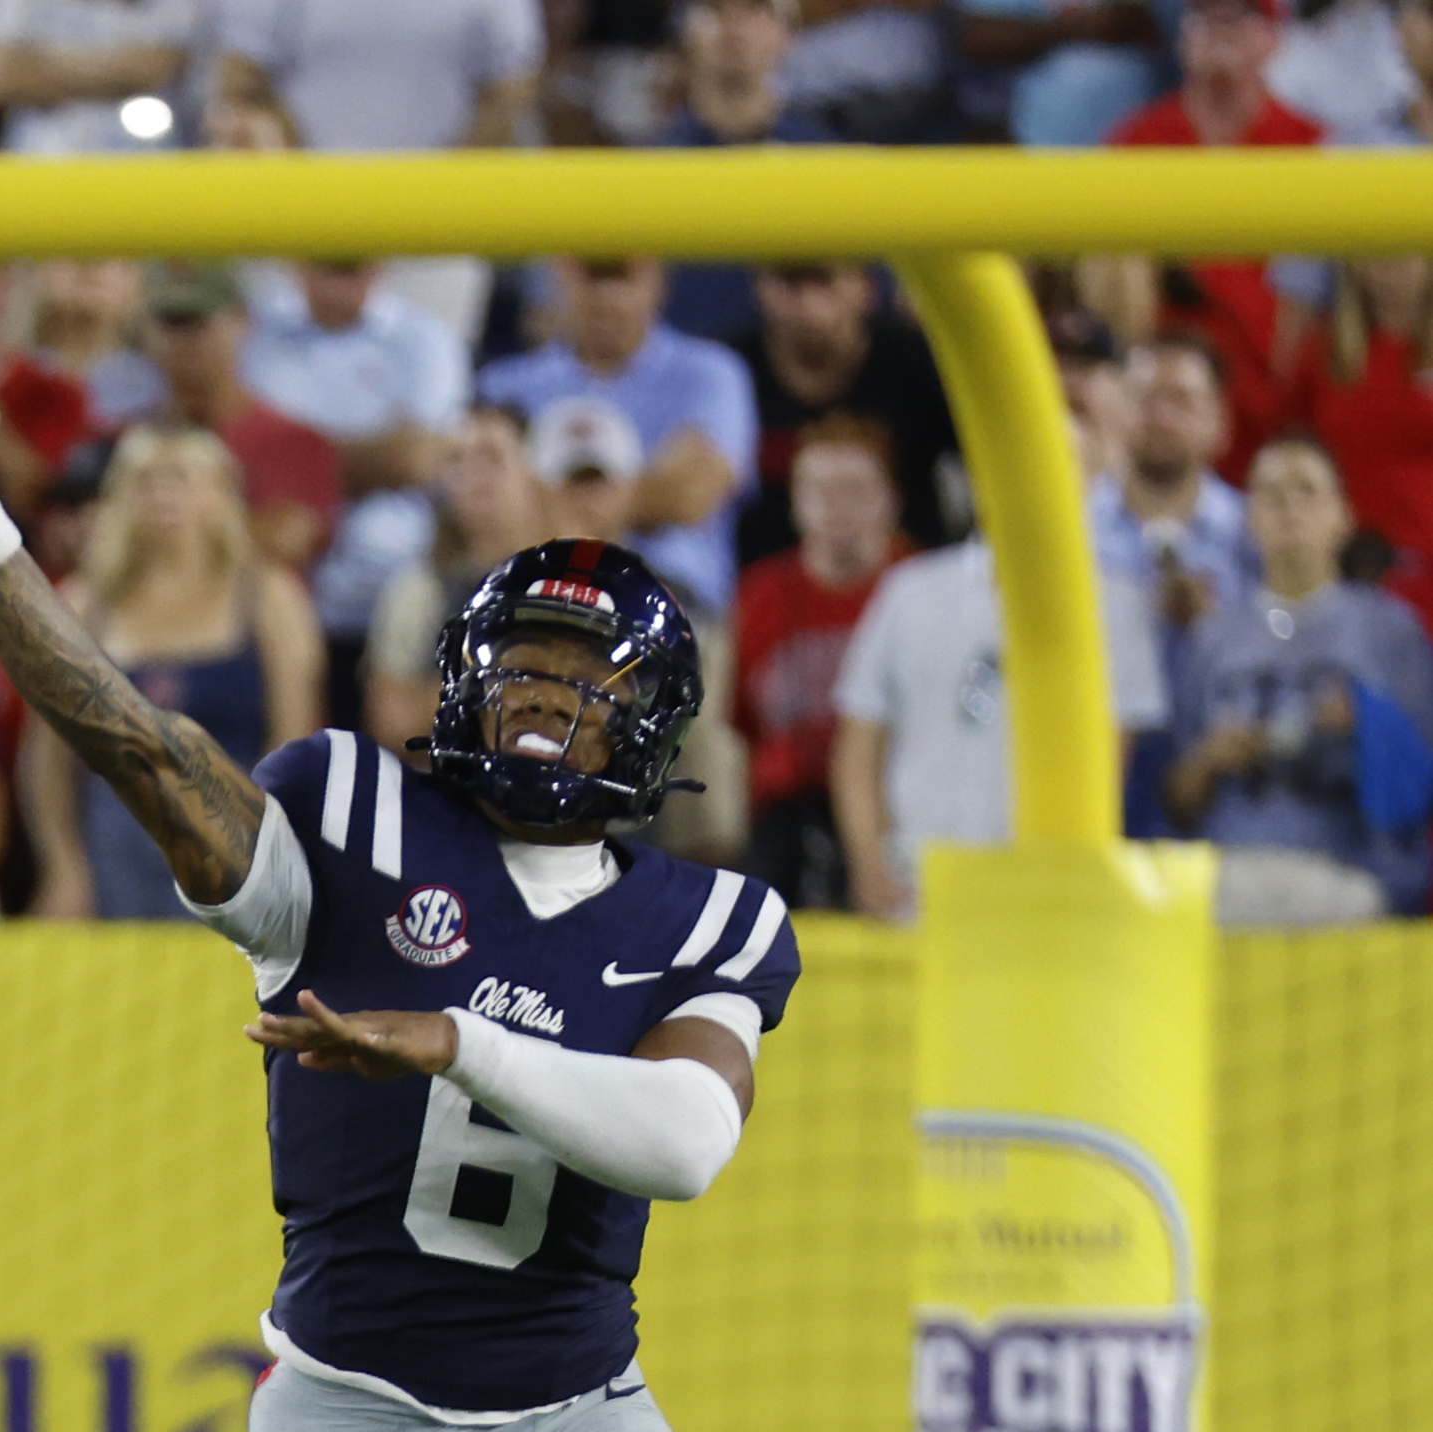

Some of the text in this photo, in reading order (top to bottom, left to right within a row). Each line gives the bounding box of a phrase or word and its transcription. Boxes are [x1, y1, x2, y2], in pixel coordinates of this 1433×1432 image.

[389, 928, 454, 965] GRADUATE
[404, 887, 462, 947] SEC
[468, 975, 566, 1035] Ole Miss
[402, 1036, 561, 1272] 6
